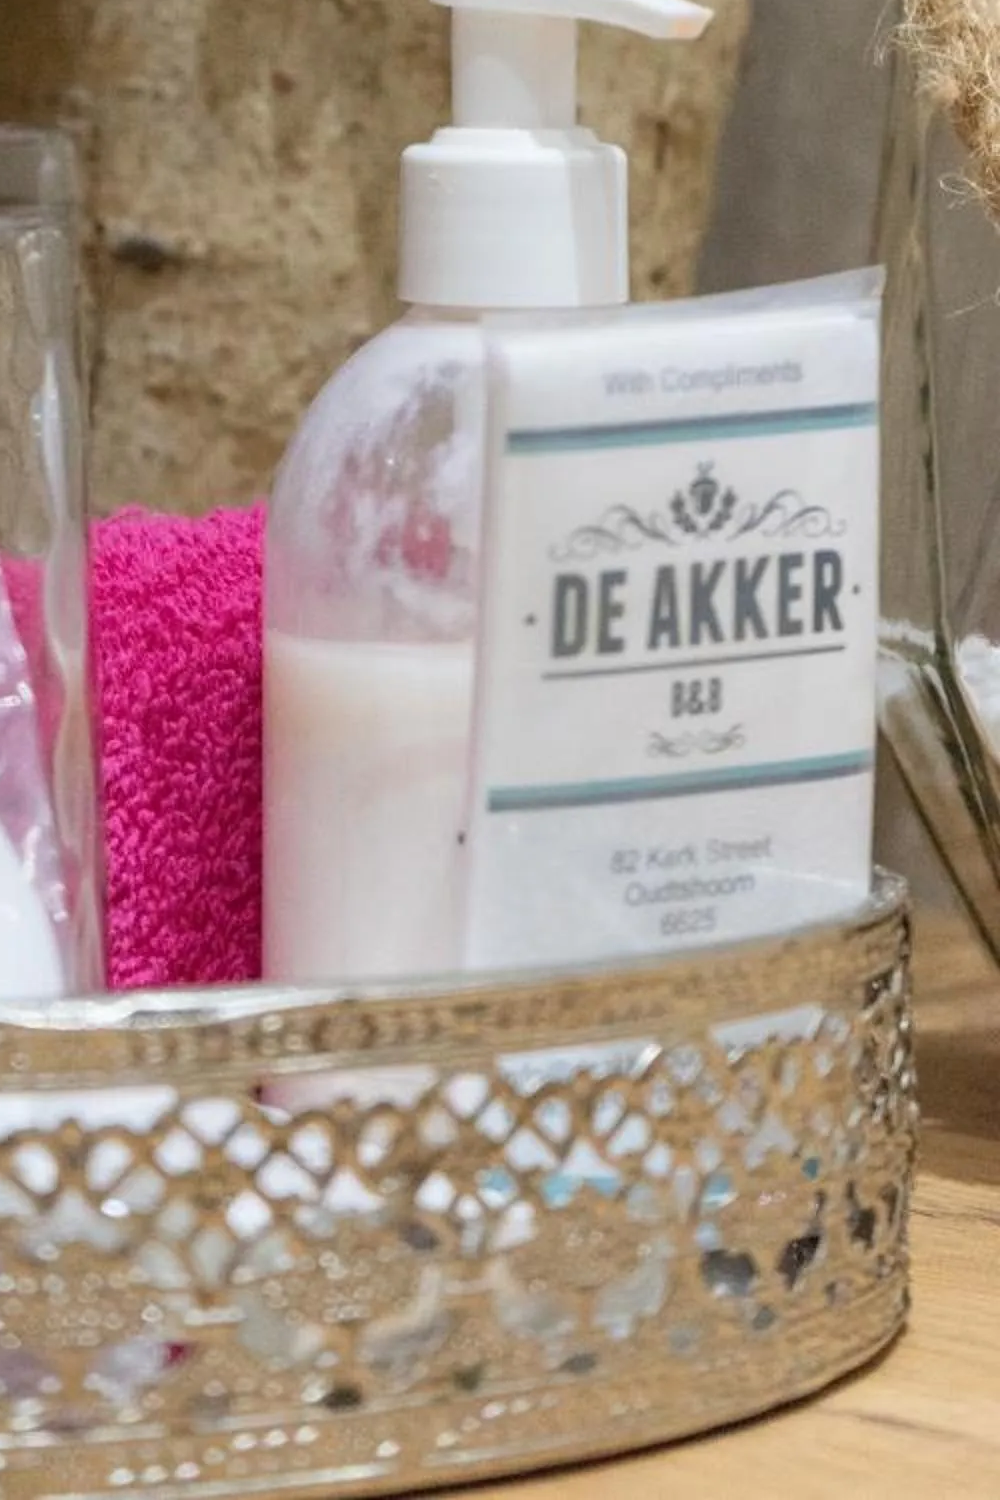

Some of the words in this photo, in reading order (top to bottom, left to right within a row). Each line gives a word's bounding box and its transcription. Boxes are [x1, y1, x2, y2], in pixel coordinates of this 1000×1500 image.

[660, 358, 803, 394] Compliments
[551, 570, 628, 659] DE
[647, 548, 845, 652] AKKER
[670, 677, 723, 718] B&B
[706, 835, 773, 864] Street
